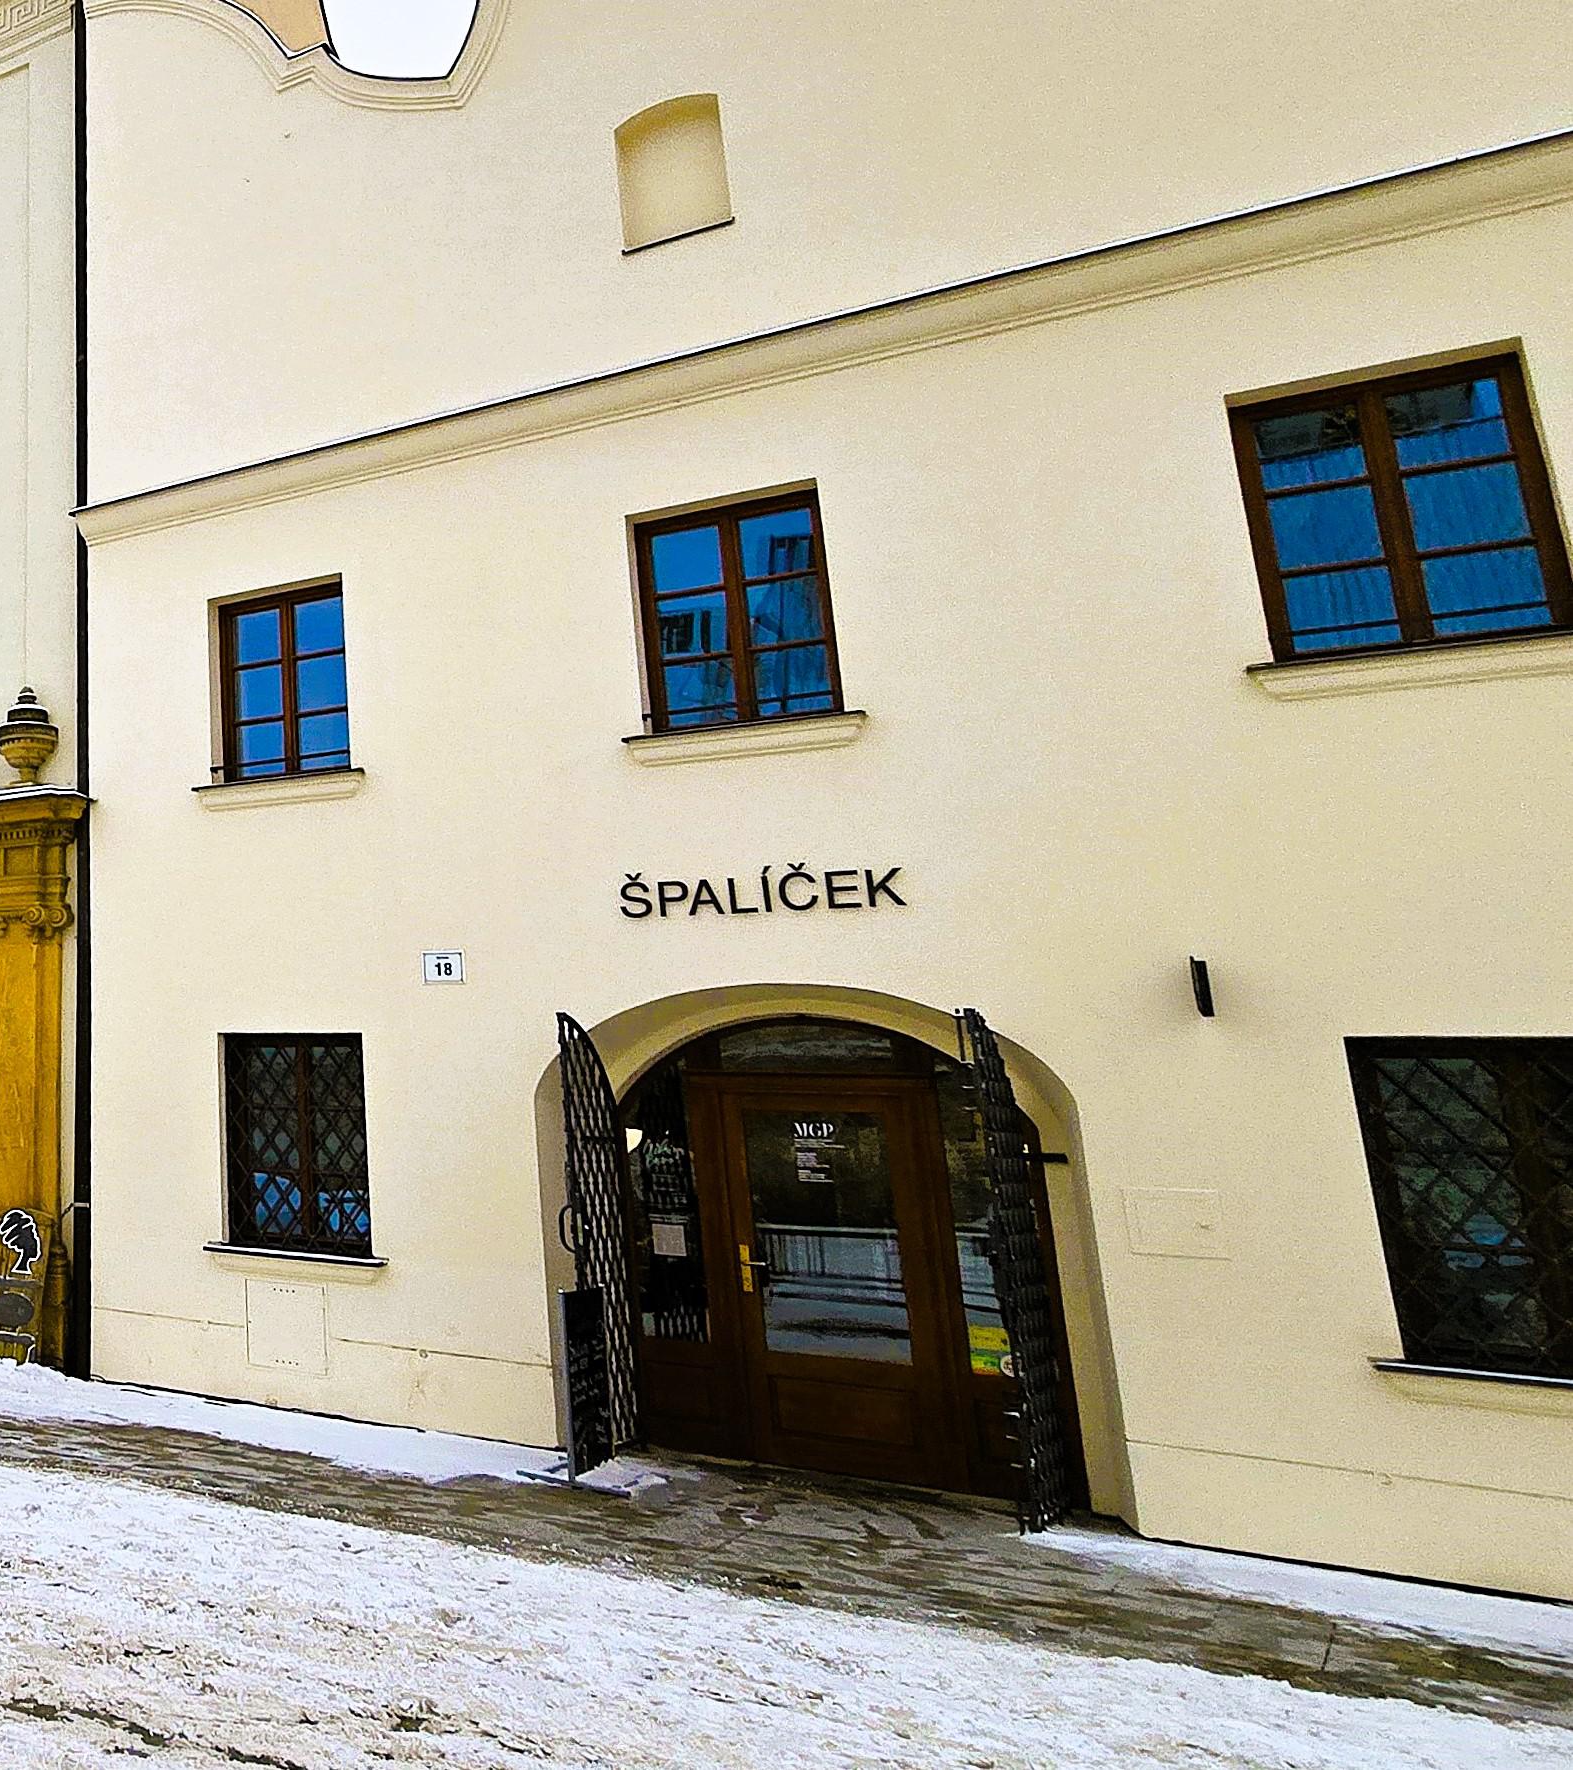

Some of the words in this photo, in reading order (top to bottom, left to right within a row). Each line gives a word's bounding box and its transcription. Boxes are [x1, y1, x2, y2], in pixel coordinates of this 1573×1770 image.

[620, 862, 907, 919] ŠPALÍČEK
[435, 962, 453, 977] 18
[793, 1122, 834, 1138] MGP
